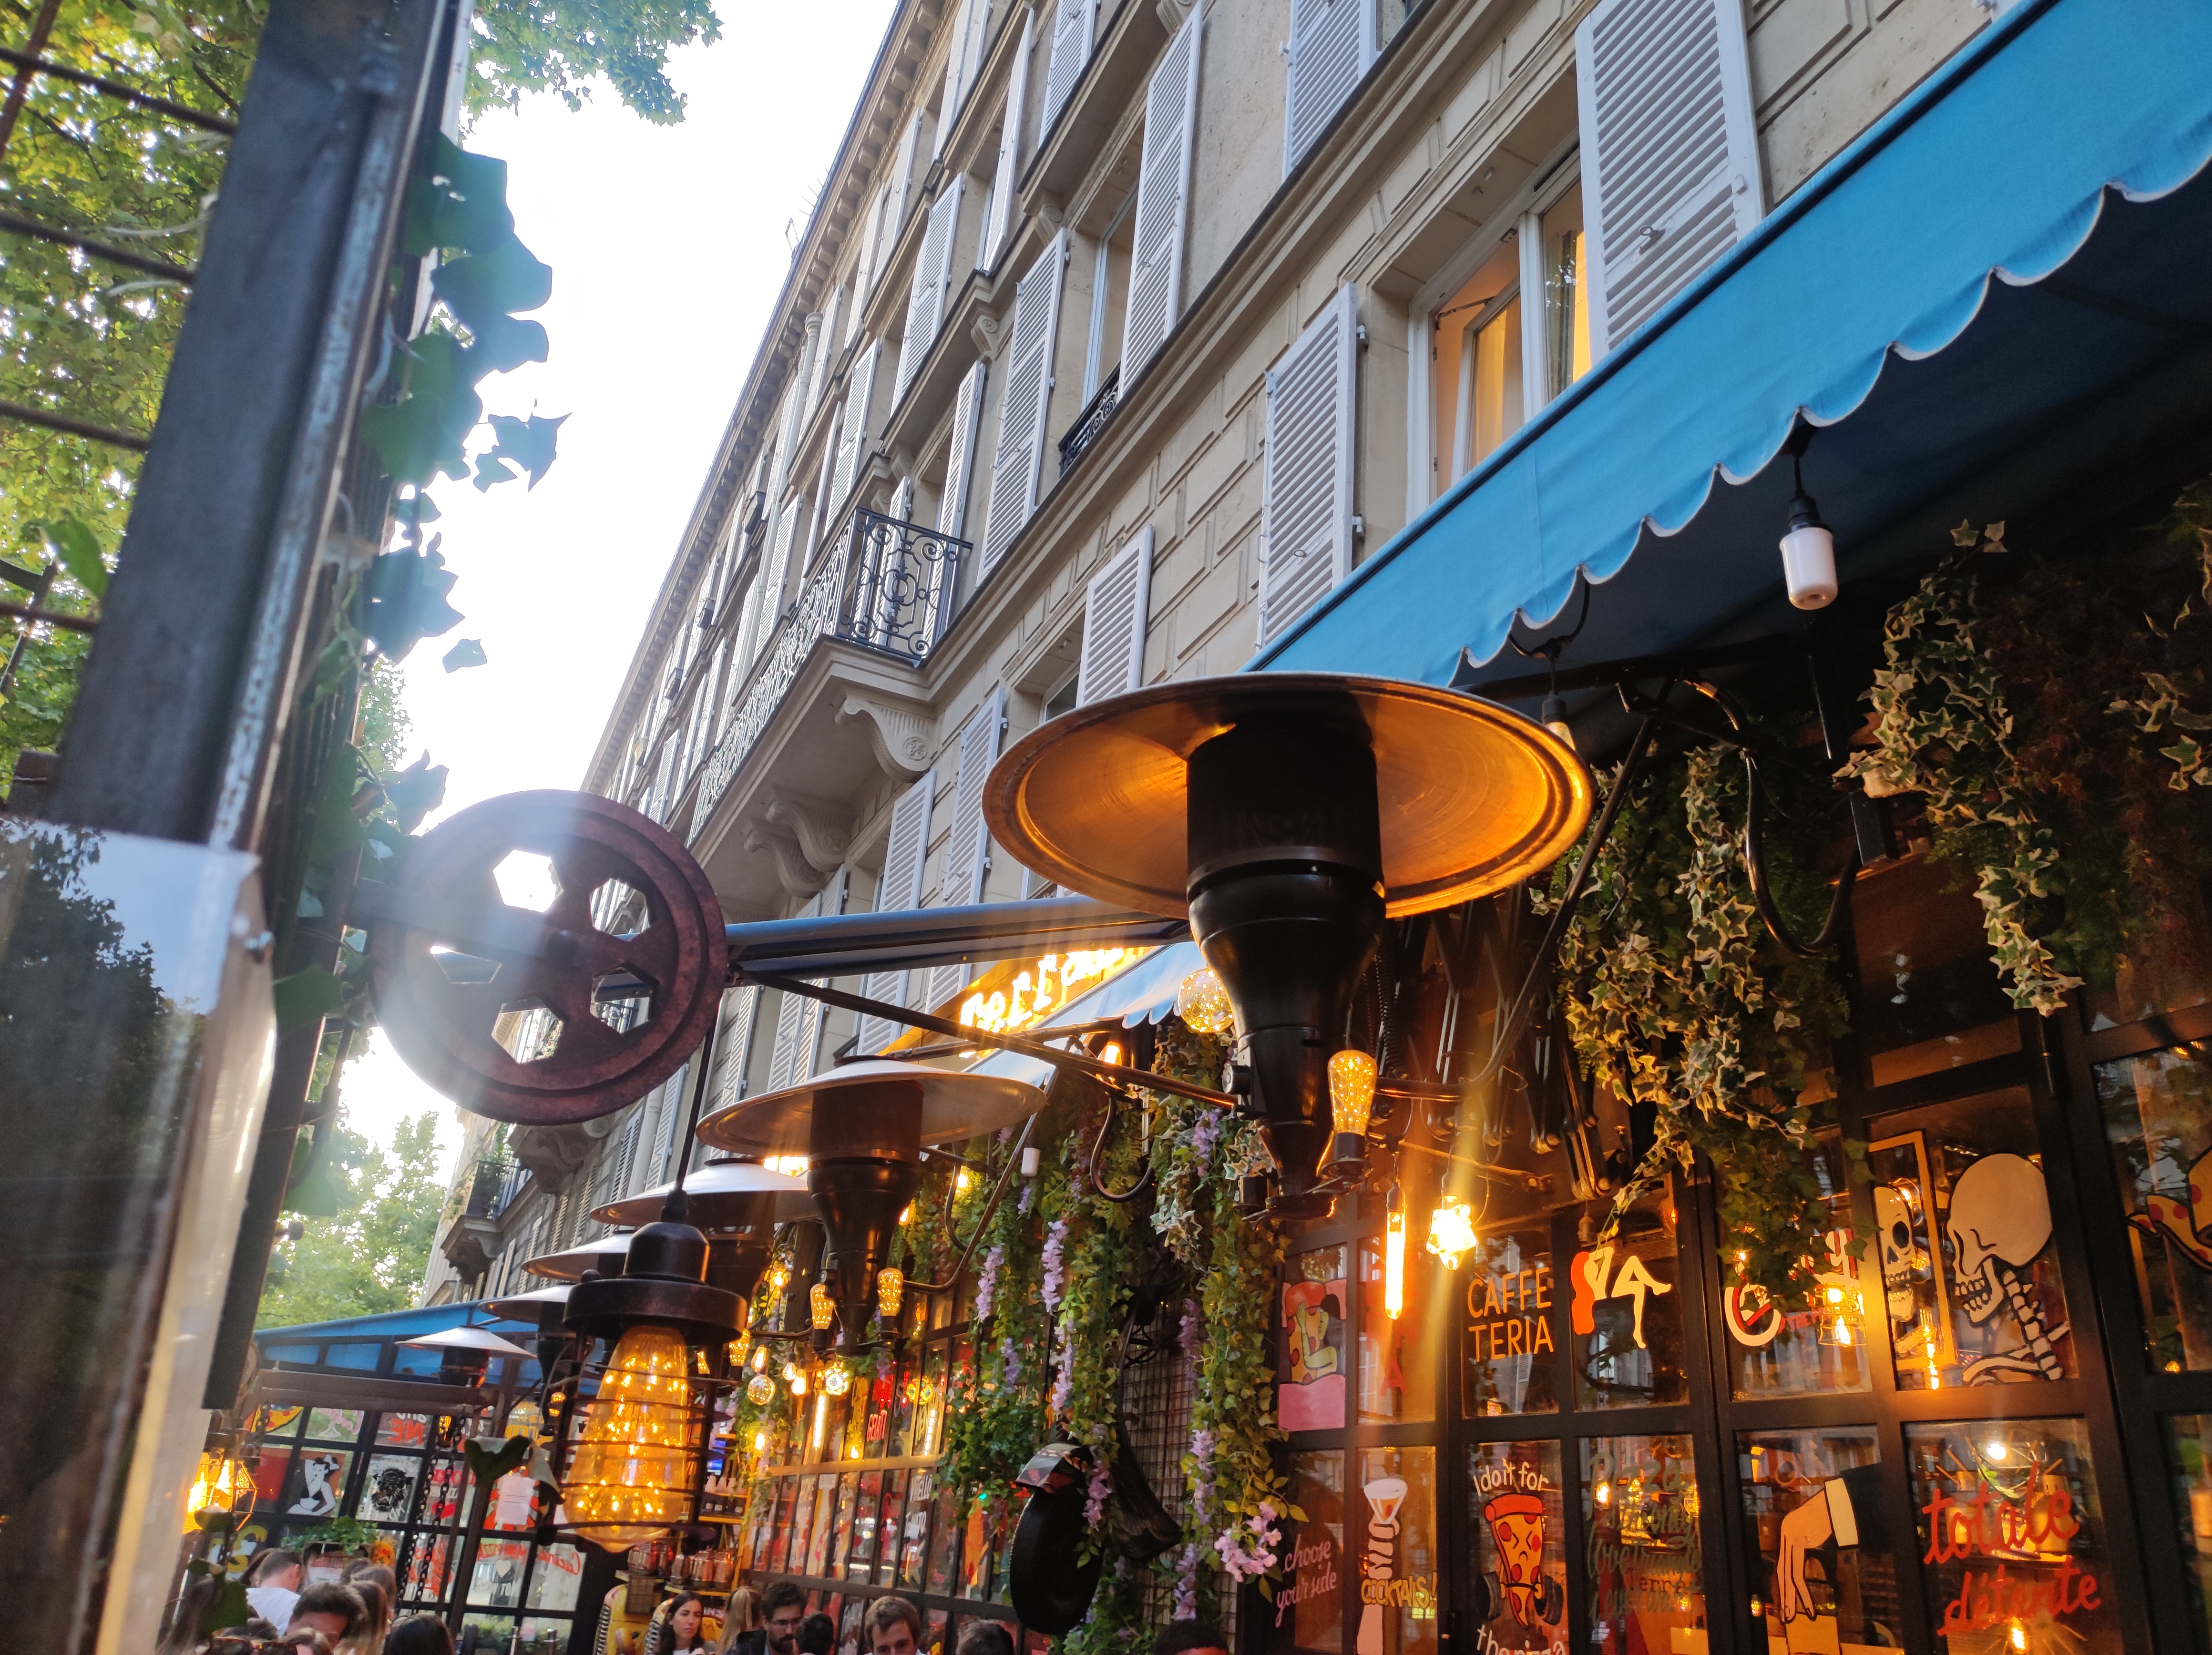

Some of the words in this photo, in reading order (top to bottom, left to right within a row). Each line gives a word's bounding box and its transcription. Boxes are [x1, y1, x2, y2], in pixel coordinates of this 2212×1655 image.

[1467, 1267, 1552, 1318] CAFFE
[1468, 1315, 1554, 1363] TERIA
[1517, 1461, 1550, 1492] for
[1922, 1460, 2080, 1565] totale
[1282, 1533, 1331, 1574] choose
[1936, 1555, 2101, 1636] détente
